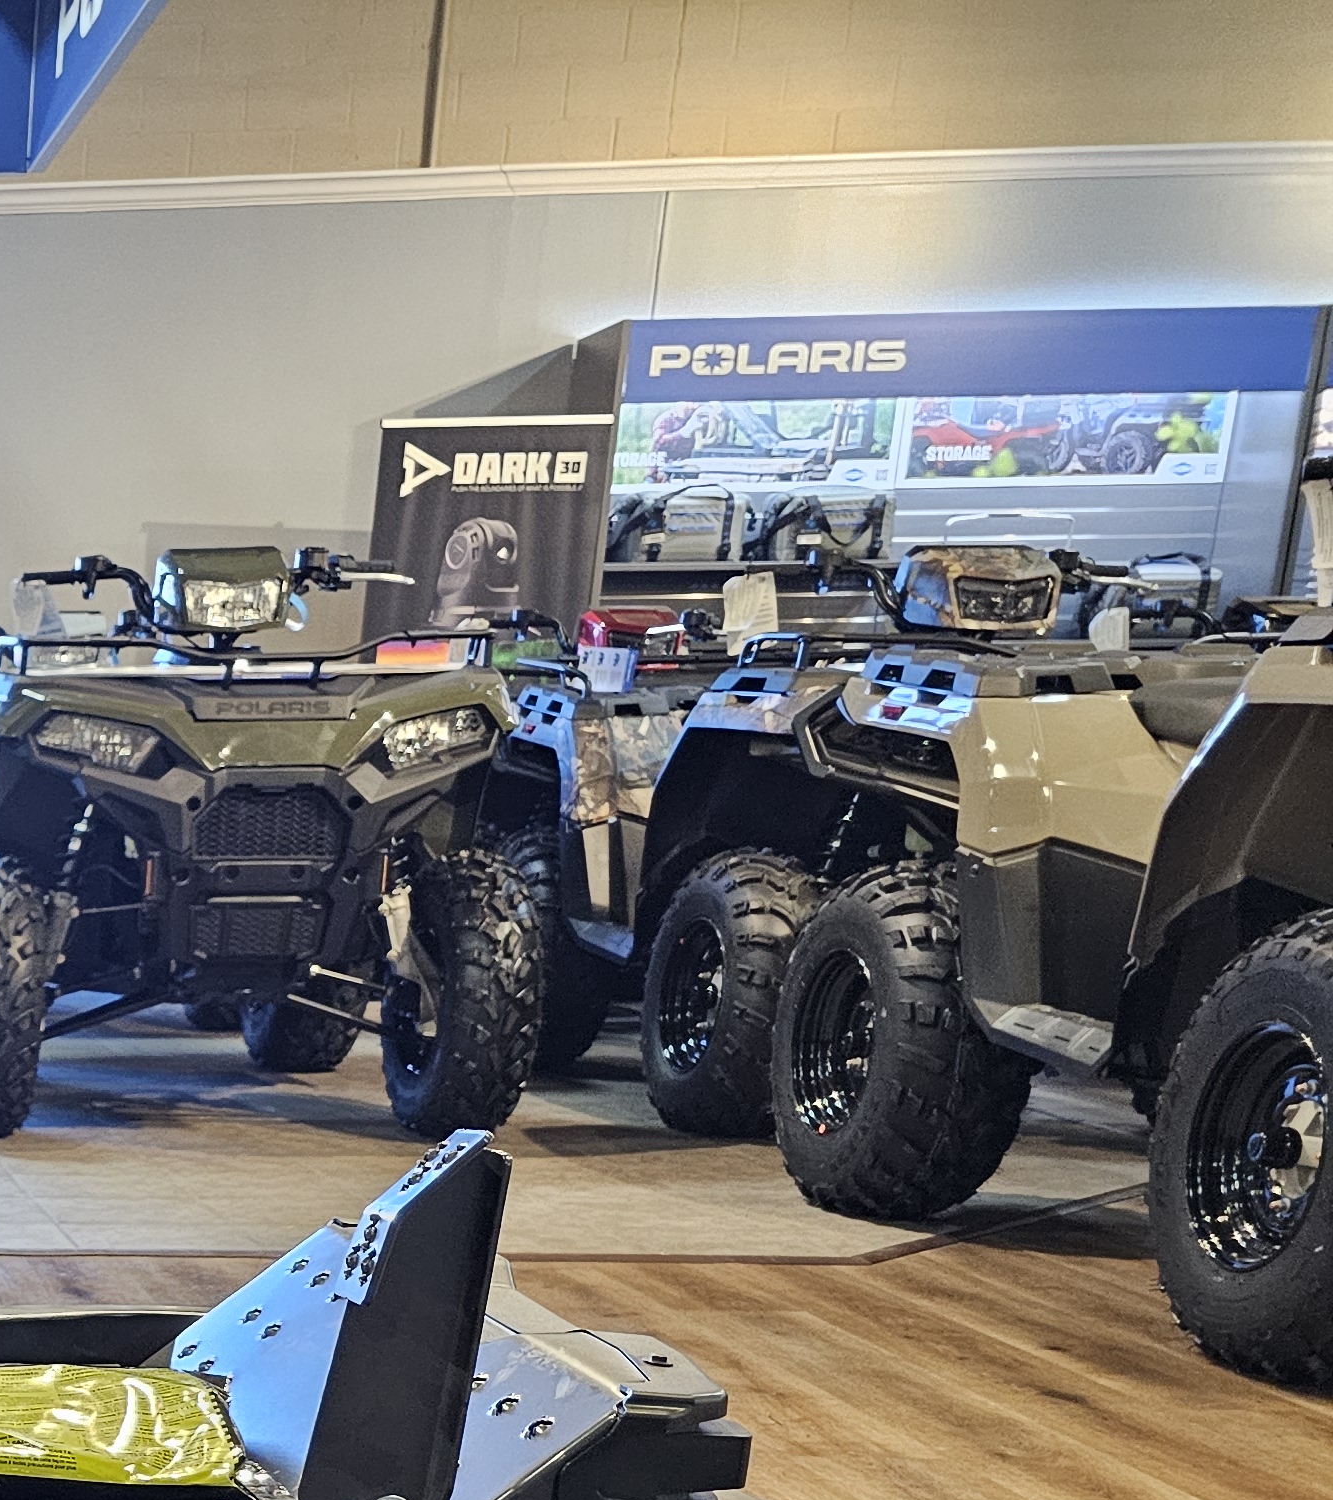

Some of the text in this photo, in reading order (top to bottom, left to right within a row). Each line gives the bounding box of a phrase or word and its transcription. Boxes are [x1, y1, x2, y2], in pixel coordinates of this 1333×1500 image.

[649, 340, 906, 377] POLARIS
[613, 451, 667, 468] TORAGE
[926, 445, 994, 461] STORAGE
[452, 452, 552, 484] DARK
[215, 701, 330, 715] POLARIS
